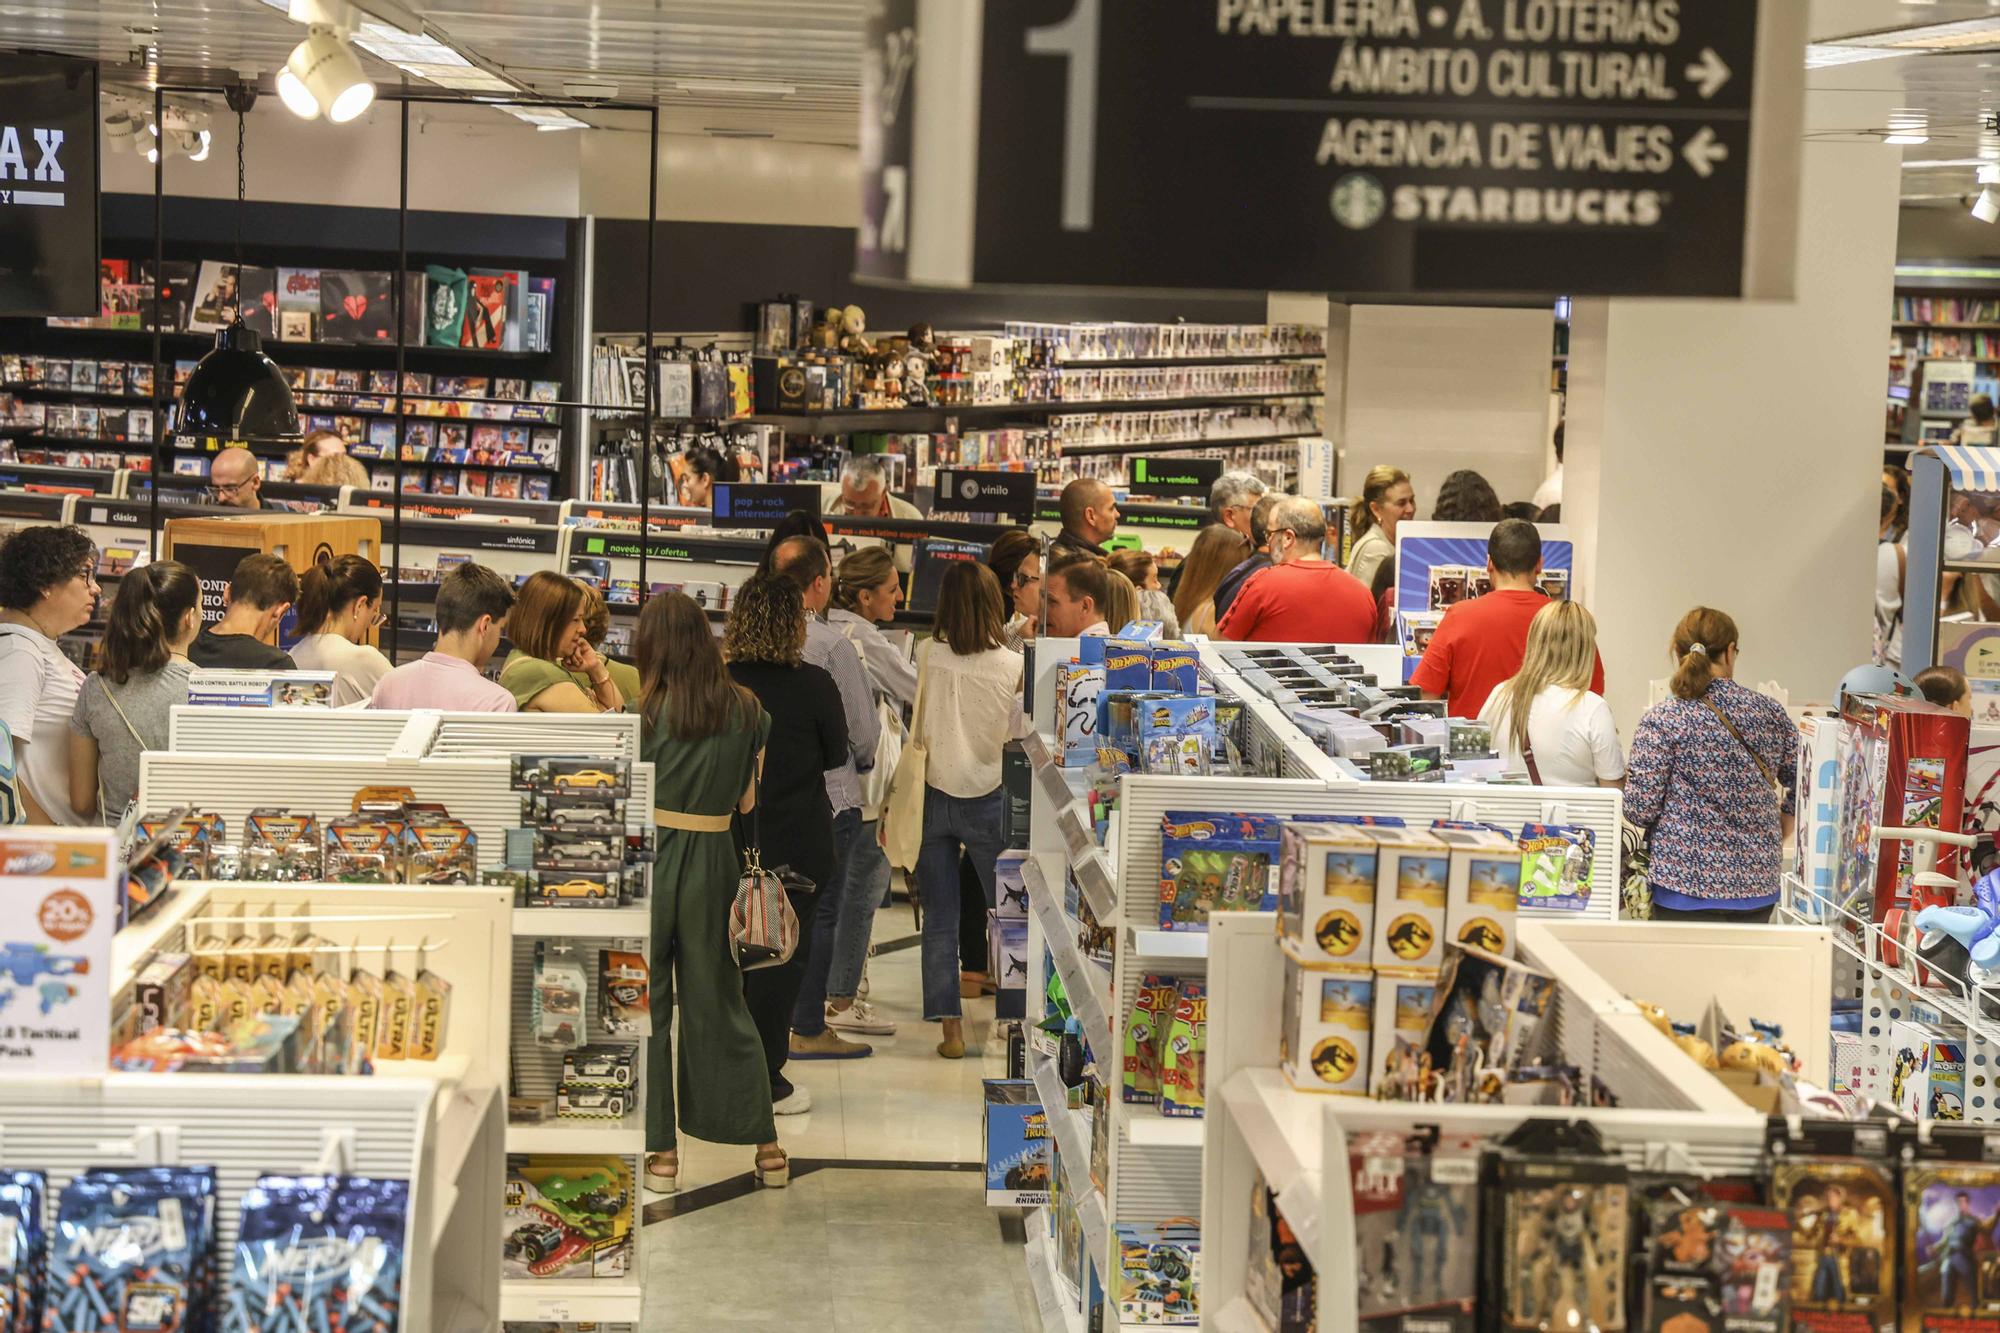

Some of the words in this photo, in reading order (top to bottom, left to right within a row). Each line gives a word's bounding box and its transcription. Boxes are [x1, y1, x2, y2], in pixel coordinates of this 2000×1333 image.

[1330, 38, 1480, 96] ÁMBITO
[1487, 51, 1677, 99] CULTURAL
[1315, 119, 1482, 168] AGENCIA
[1490, 123, 1542, 169] DE
[1549, 124, 1674, 172] VIAJES
[1393, 186, 1663, 225] STARBUCKS
[1148, 475, 1159, 483] los
[1166, 475, 1199, 484] vendidos
[981, 485, 1009, 496] vinilo
[735, 498, 753, 508] pop
[763, 497, 785, 507] rock
[113, 512, 138, 523] clásica
[507, 536, 536, 546] sinfónica
[660, 546, 689, 557] ofertas
[427, 997, 438, 1056] ULTRA
